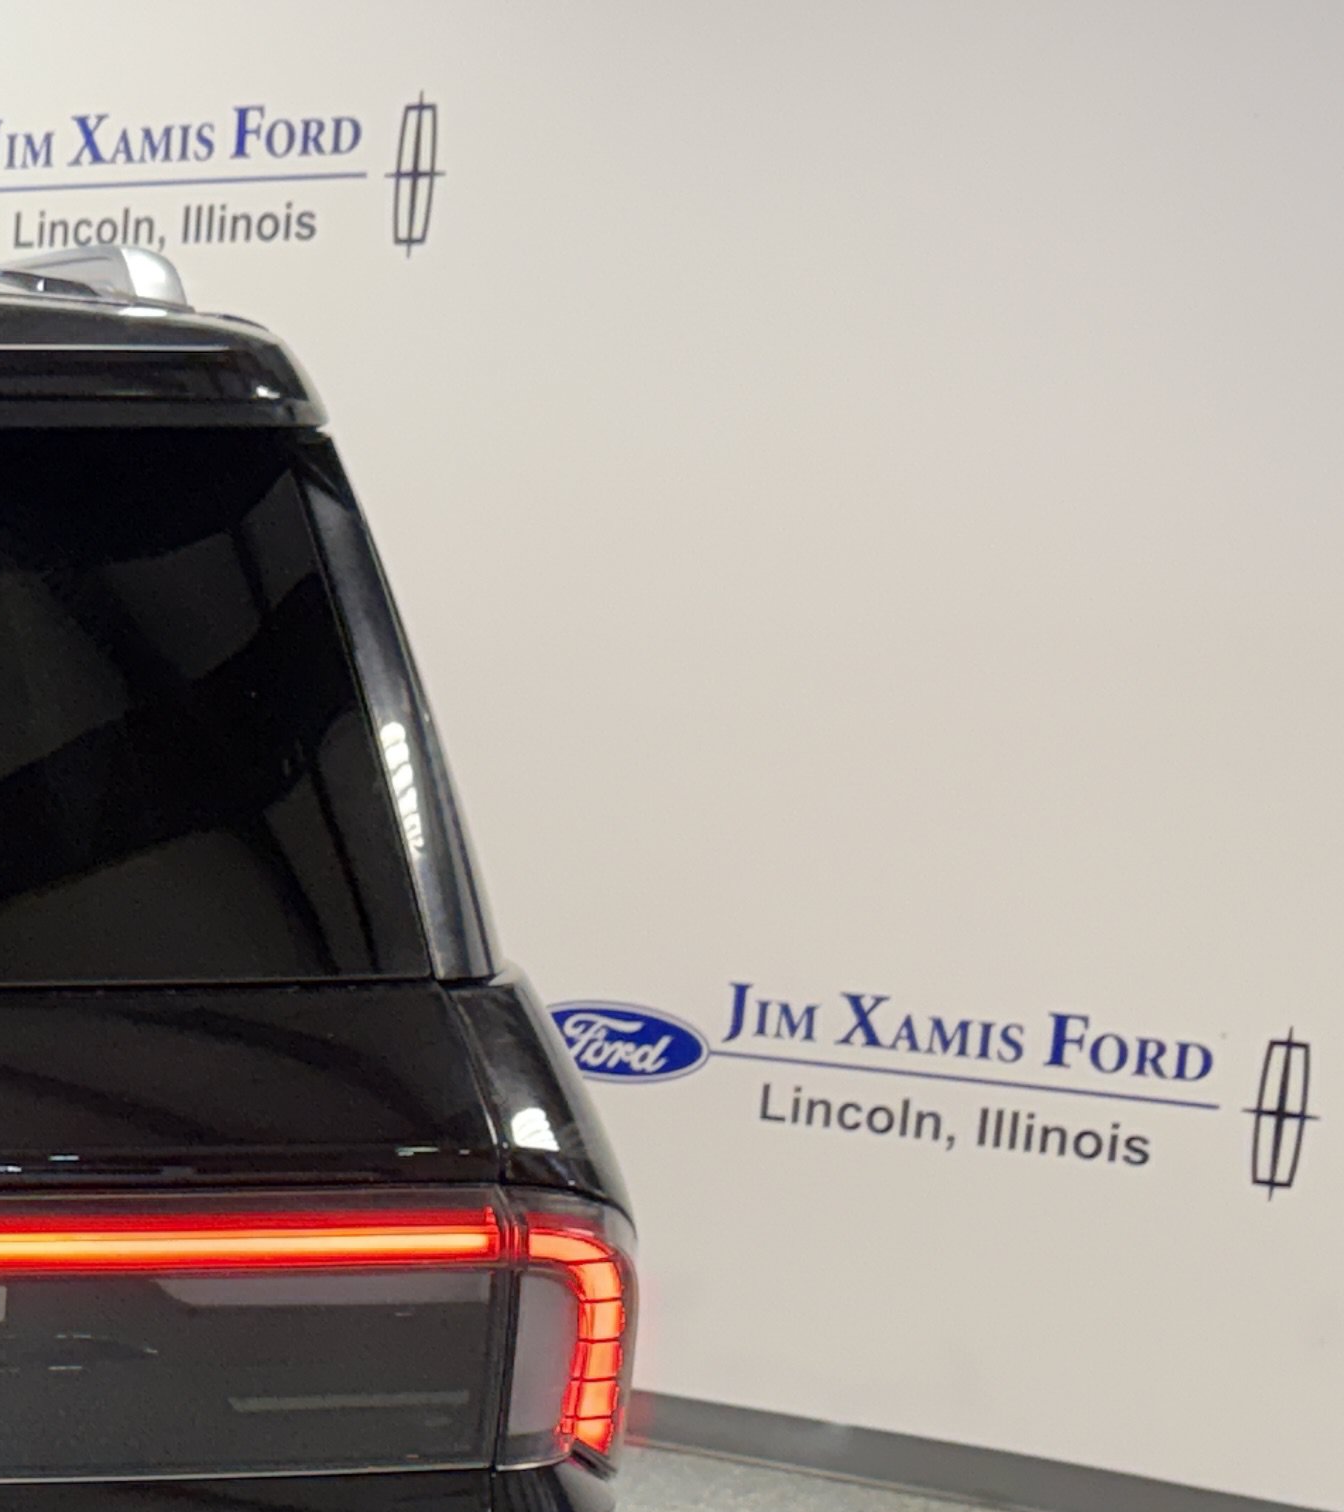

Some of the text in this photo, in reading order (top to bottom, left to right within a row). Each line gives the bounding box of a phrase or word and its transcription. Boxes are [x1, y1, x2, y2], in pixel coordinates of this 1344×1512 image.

[67, 113, 215, 167] XAMIS
[230, 105, 362, 159] FORD
[14, 202, 317, 251] Lincoln, Illinois
[562, 1013, 671, 1075] Ford
[722, 982, 1215, 1084] JIM XAMIS FORD
[759, 1082, 1151, 1167] Lincoln, Illinois
